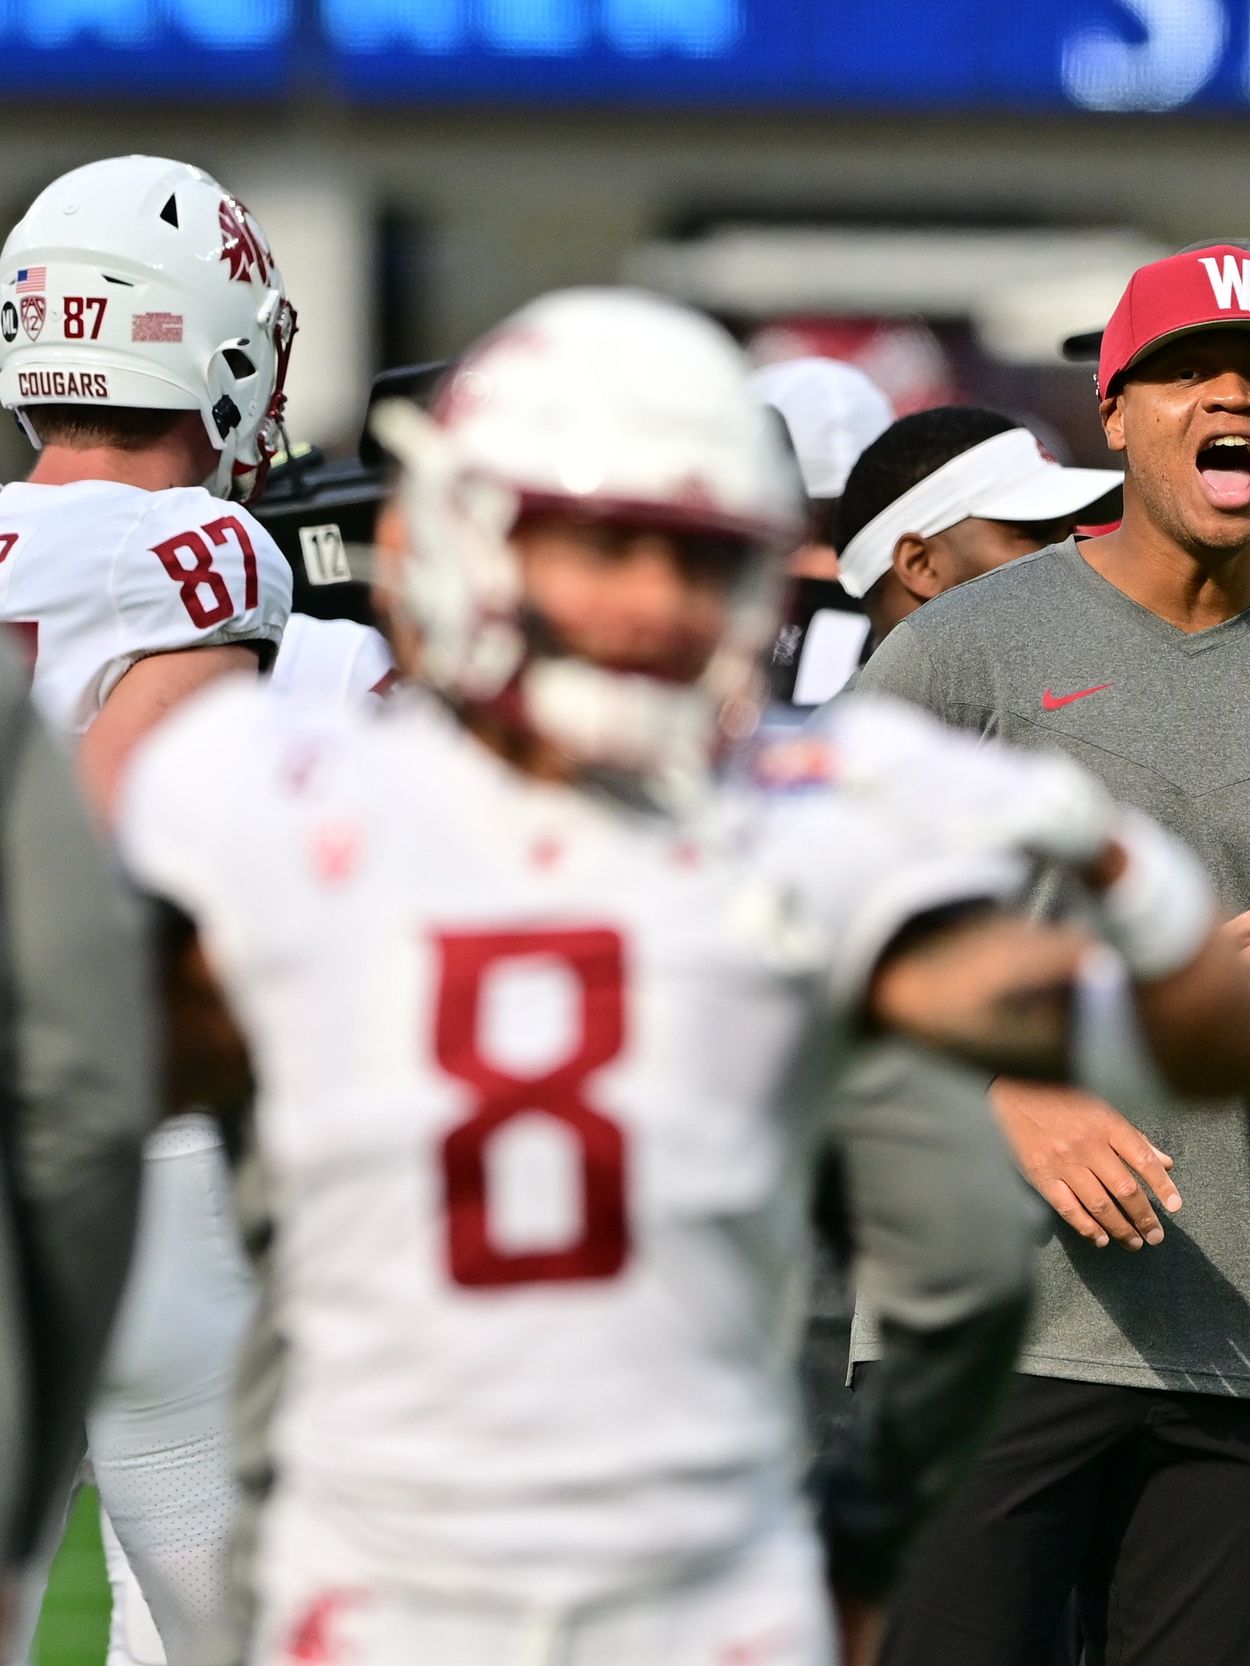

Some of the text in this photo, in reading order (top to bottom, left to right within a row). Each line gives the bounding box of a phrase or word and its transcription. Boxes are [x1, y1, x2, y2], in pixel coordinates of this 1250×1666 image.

[63, 296, 107, 339] 87
[18, 372, 108, 398] COUGARS
[147, 516, 258, 629] 87
[311, 531, 346, 579] 12
[430, 924, 632, 1289] 8
